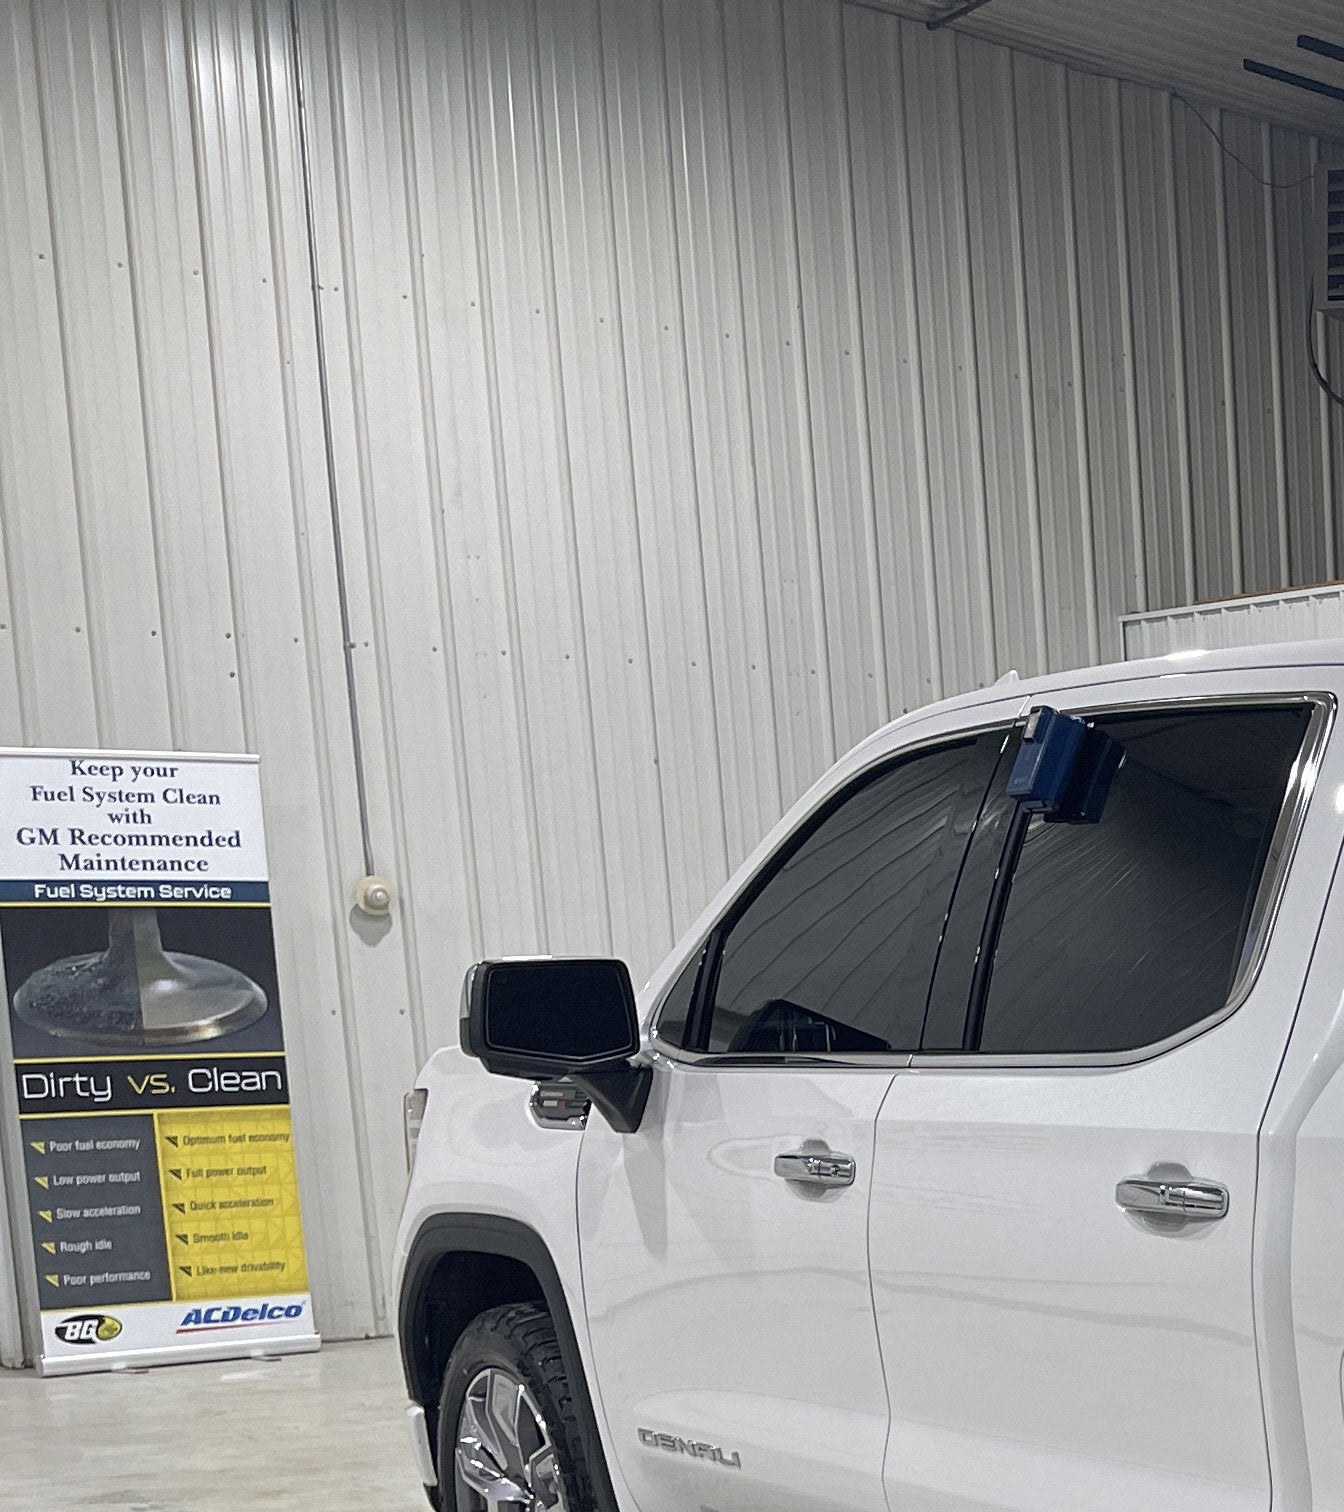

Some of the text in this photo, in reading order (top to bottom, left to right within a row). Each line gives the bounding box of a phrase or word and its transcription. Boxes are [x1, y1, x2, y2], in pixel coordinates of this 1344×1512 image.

[70, 759, 179, 782] Keep your
[30, 785, 221, 807] Fuel System Clean
[107, 808, 152, 825] with
[16, 828, 242, 848] GM Recommended
[59, 854, 209, 872] Maintenance
[34, 884, 232, 902] Fuel System Service
[22, 1068, 282, 1103] Dirty vs. Clean
[49, 1138, 140, 1152] Poor fuel economy
[182, 1132, 291, 1148] Optimum fuel economy
[53, 1171, 141, 1186] Low power output
[186, 1164, 268, 1180] Full power output
[56, 1204, 141, 1220] Slow acceleration
[189, 1196, 274, 1212] Quick acceleration
[193, 1230, 249, 1244] Smooth idle
[60, 1238, 112, 1255] Rough idle
[241, 1262, 286, 1276] drivability
[63, 1270, 151, 1286] Poor performance
[180, 1304, 302, 1326] ACDelco
[638, 1427, 742, 1470] DENALI
